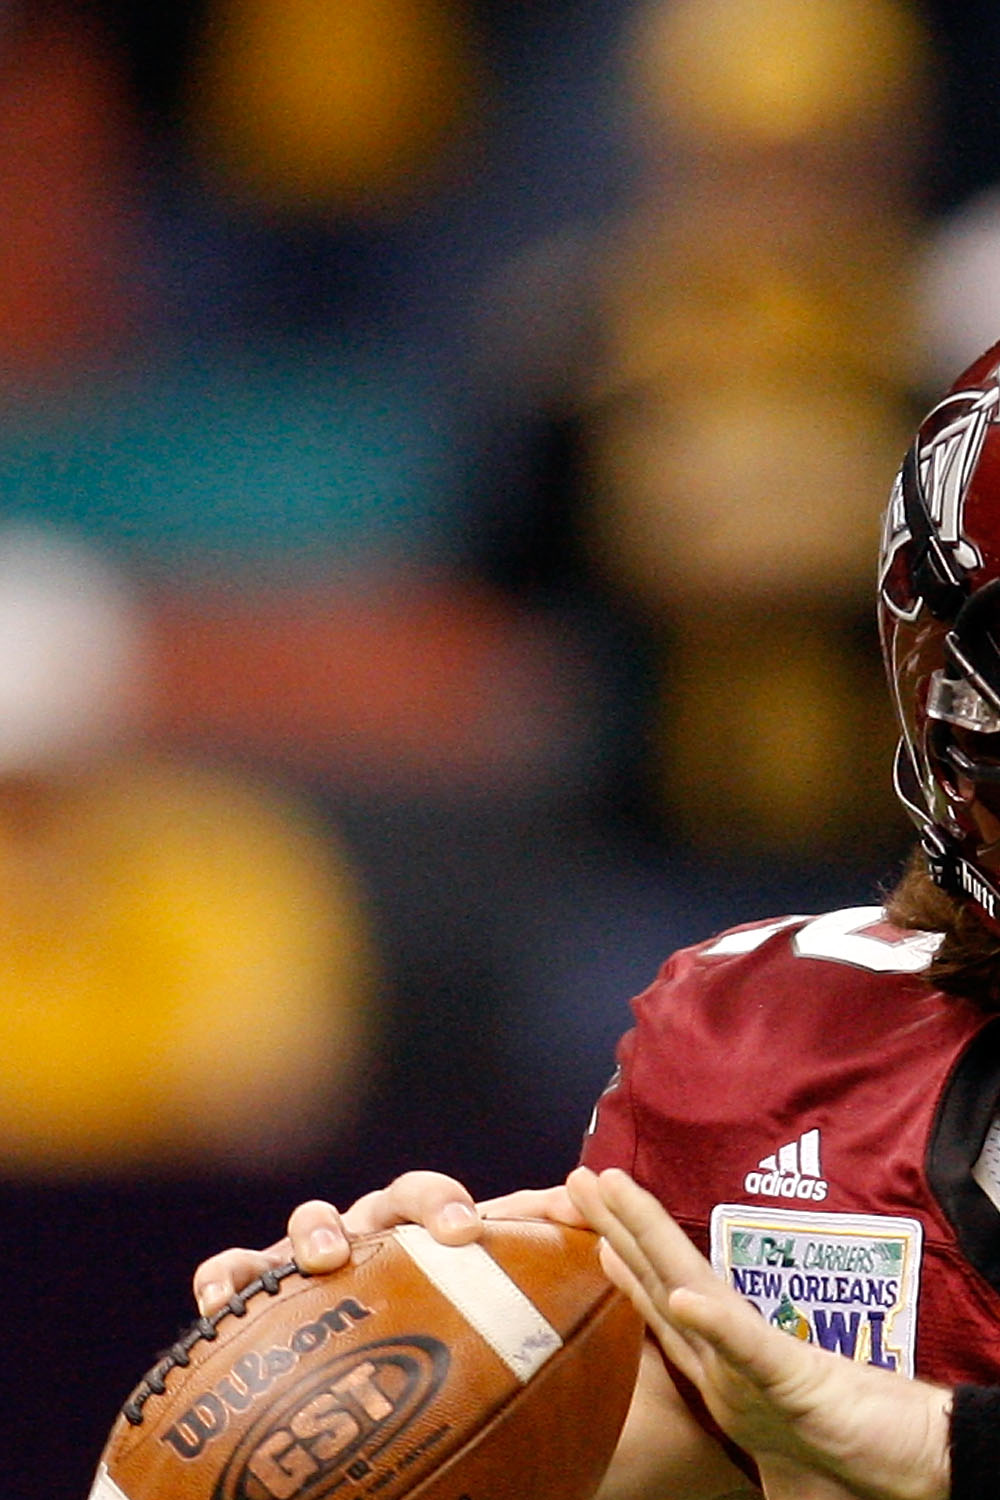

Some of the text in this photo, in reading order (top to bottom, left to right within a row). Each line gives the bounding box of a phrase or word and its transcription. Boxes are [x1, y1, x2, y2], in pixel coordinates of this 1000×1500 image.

[744, 1170, 828, 1201] adidas
[803, 1242, 875, 1274] CARRIERS
[731, 1267, 899, 1308] NEW ORLEANS
[160, 1296, 376, 1460] Wilson
[249, 1361, 396, 1500] GST
